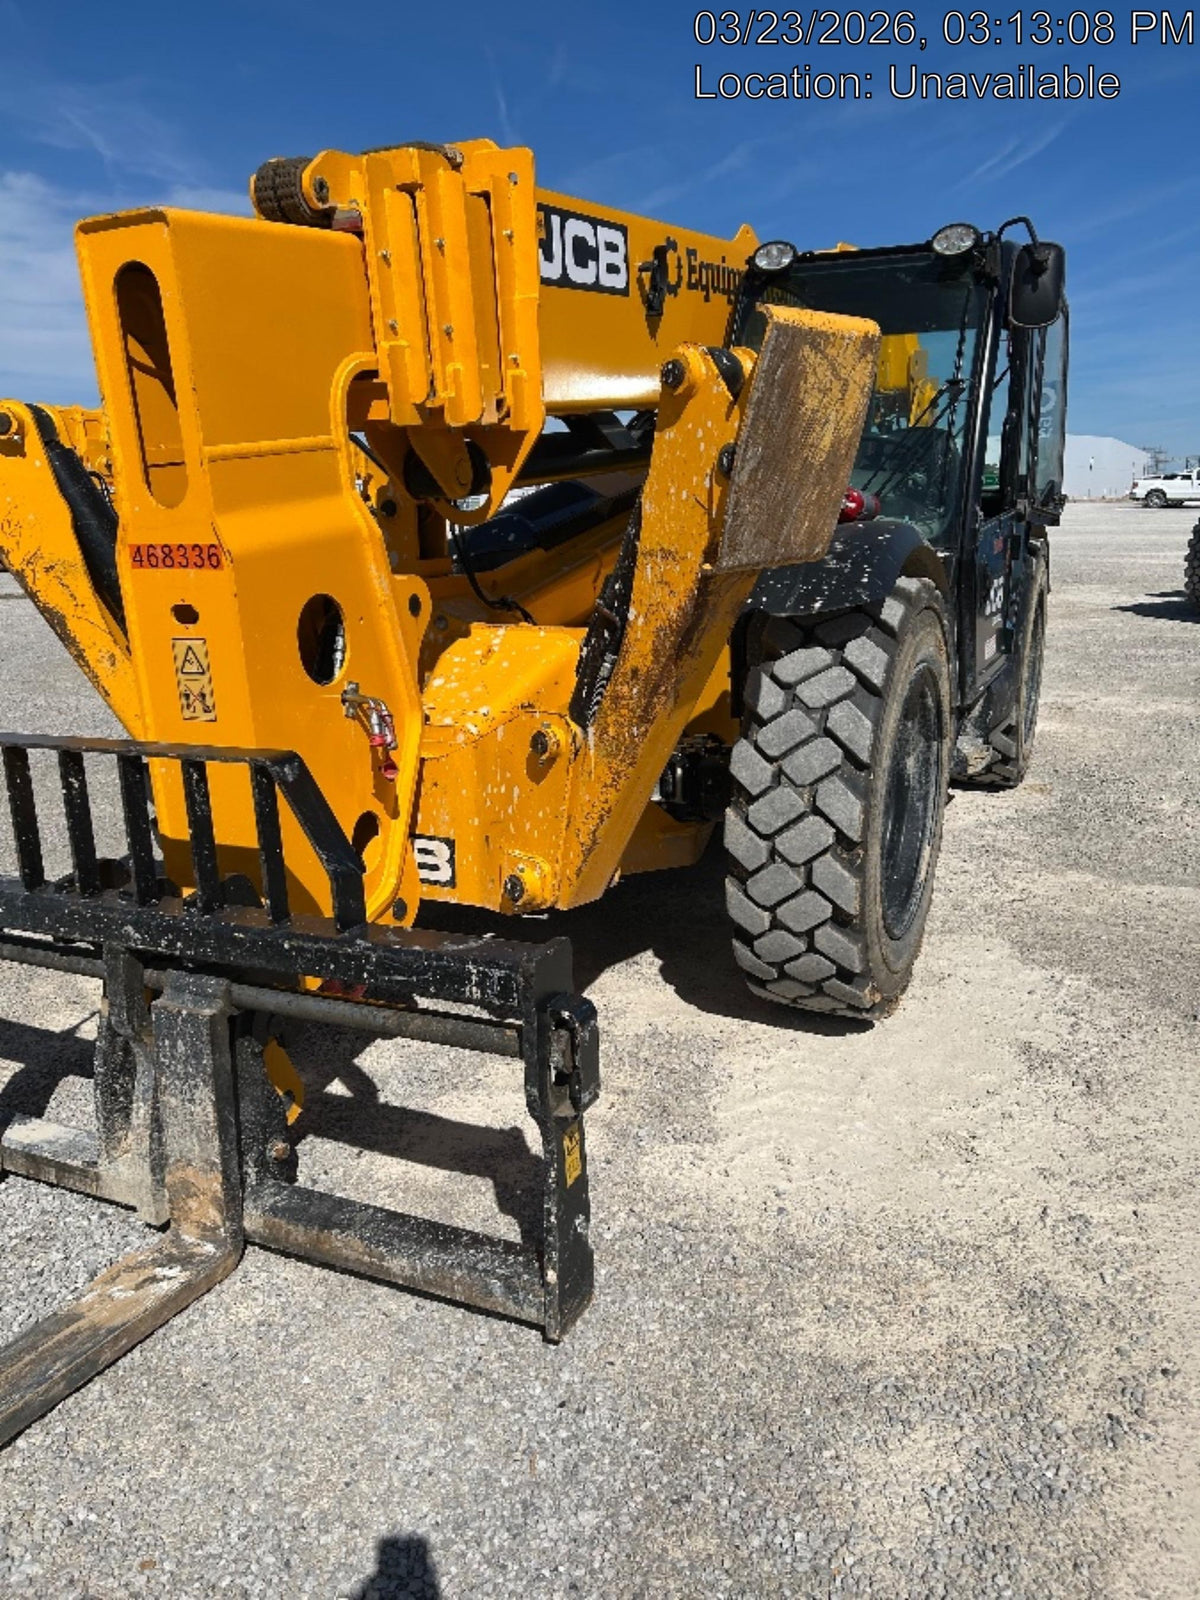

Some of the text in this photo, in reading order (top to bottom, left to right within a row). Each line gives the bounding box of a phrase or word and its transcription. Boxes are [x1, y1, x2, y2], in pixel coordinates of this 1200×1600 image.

[539, 214, 628, 289] JCB
[685, 246, 742, 306] Equip
[132, 543, 221, 569] 468336
